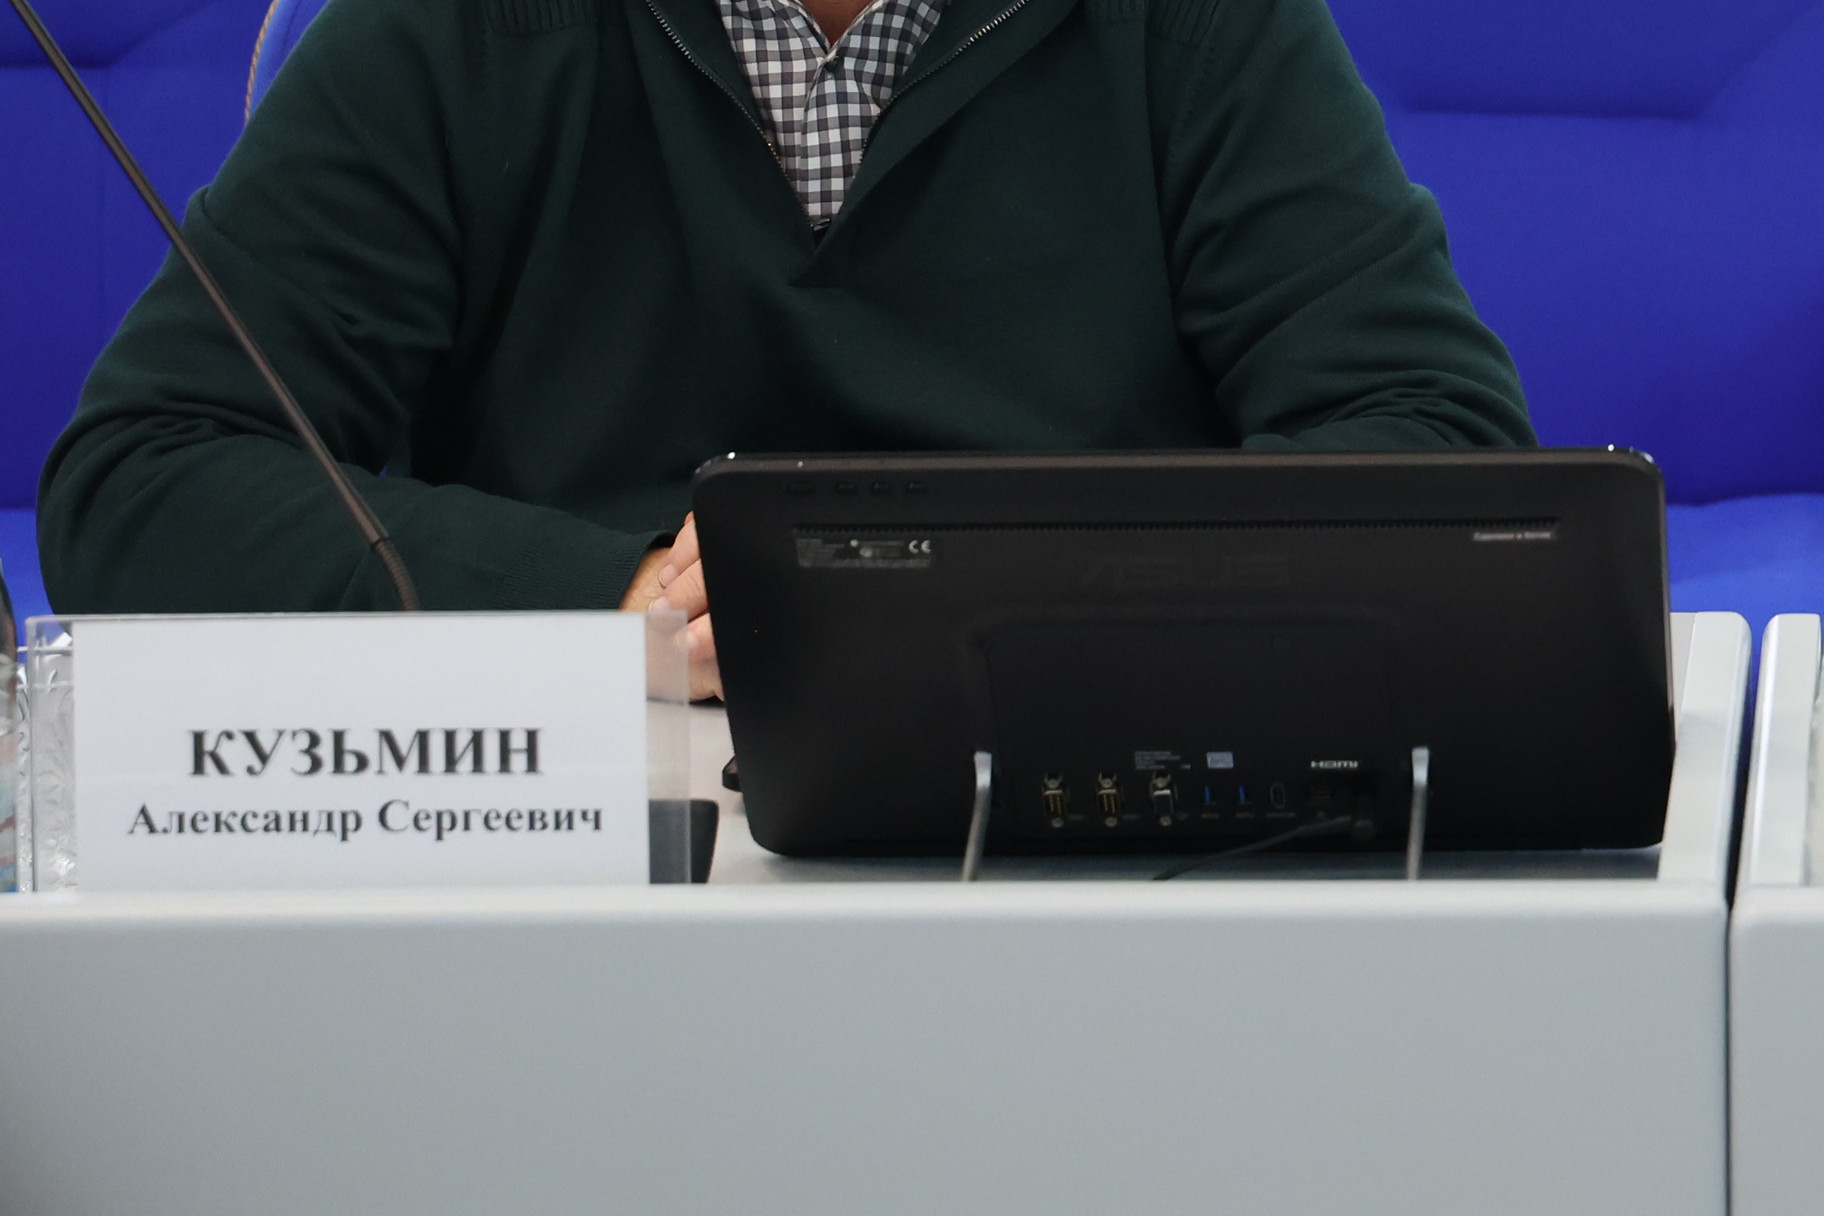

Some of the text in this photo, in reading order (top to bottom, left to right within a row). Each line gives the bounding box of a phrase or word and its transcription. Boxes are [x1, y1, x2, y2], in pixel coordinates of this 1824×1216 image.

[191, 728, 541, 776] КУЗЬМИН
[128, 800, 603, 843] Александр Сергеевич
